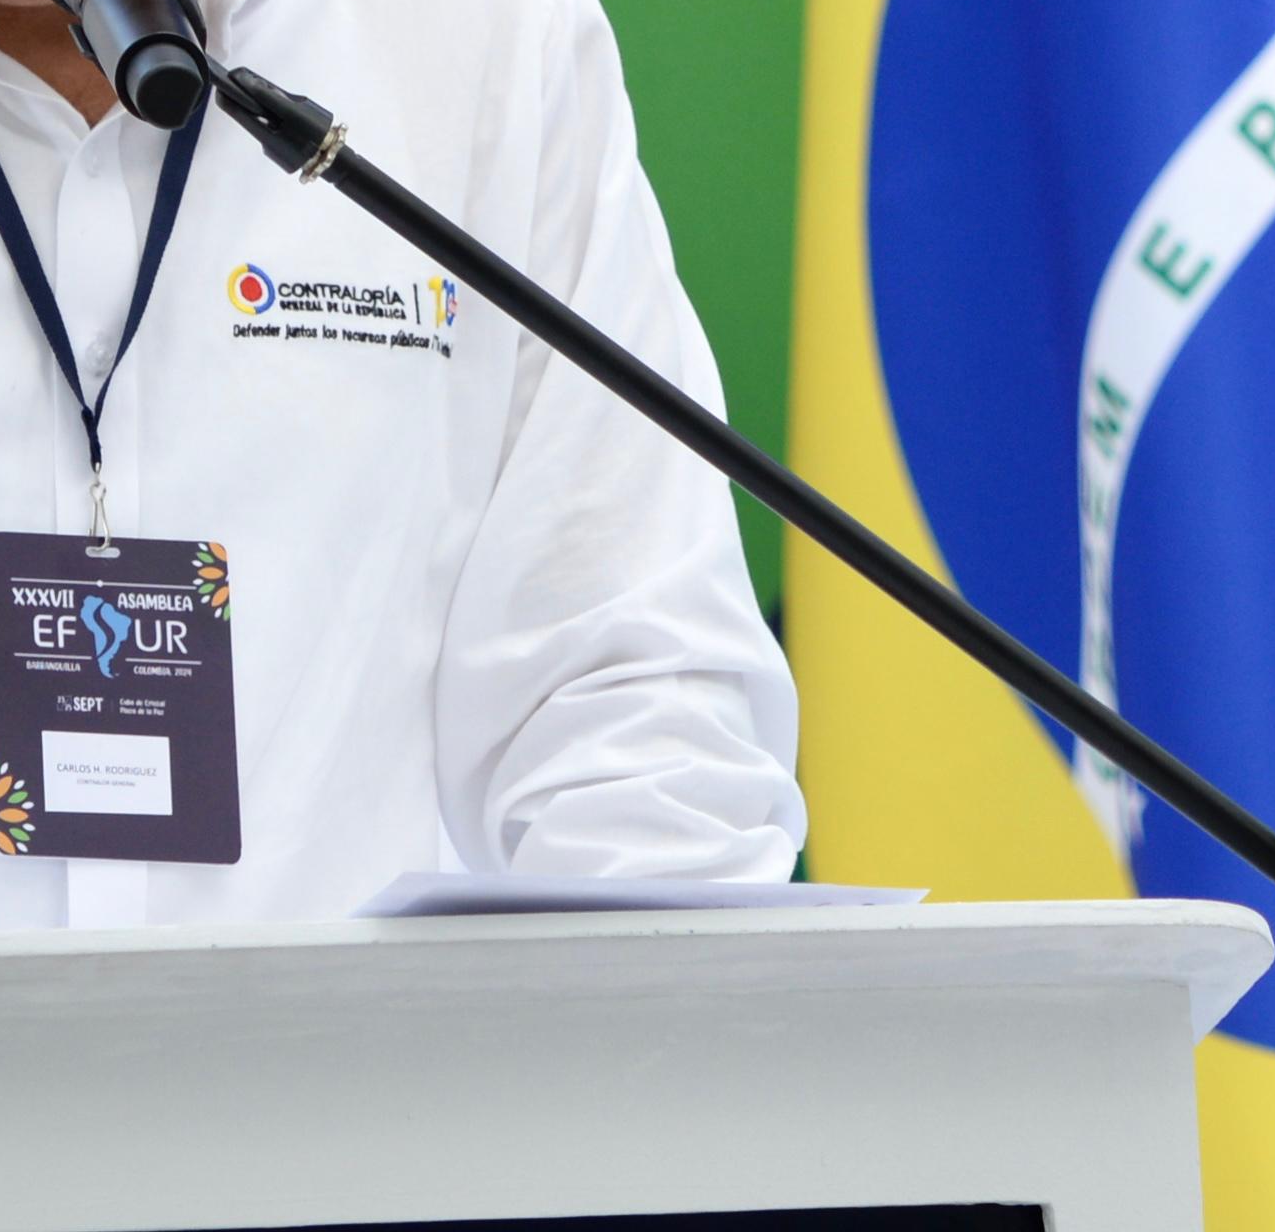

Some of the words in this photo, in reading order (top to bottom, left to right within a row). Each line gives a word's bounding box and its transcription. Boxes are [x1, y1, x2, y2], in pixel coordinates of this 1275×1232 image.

[1140, 221, 1215, 301] E
[278, 282, 405, 307] CONTRALORÍA
[342, 302, 352, 314] LA
[233, 323, 280, 338] Defender
[322, 324, 337, 339] los
[12, 587, 74, 609] XXXVII
[117, 592, 194, 612] ASAMBLEA
[73, 696, 103, 713] SEPT
[56, 763, 91, 774] CARLOS
